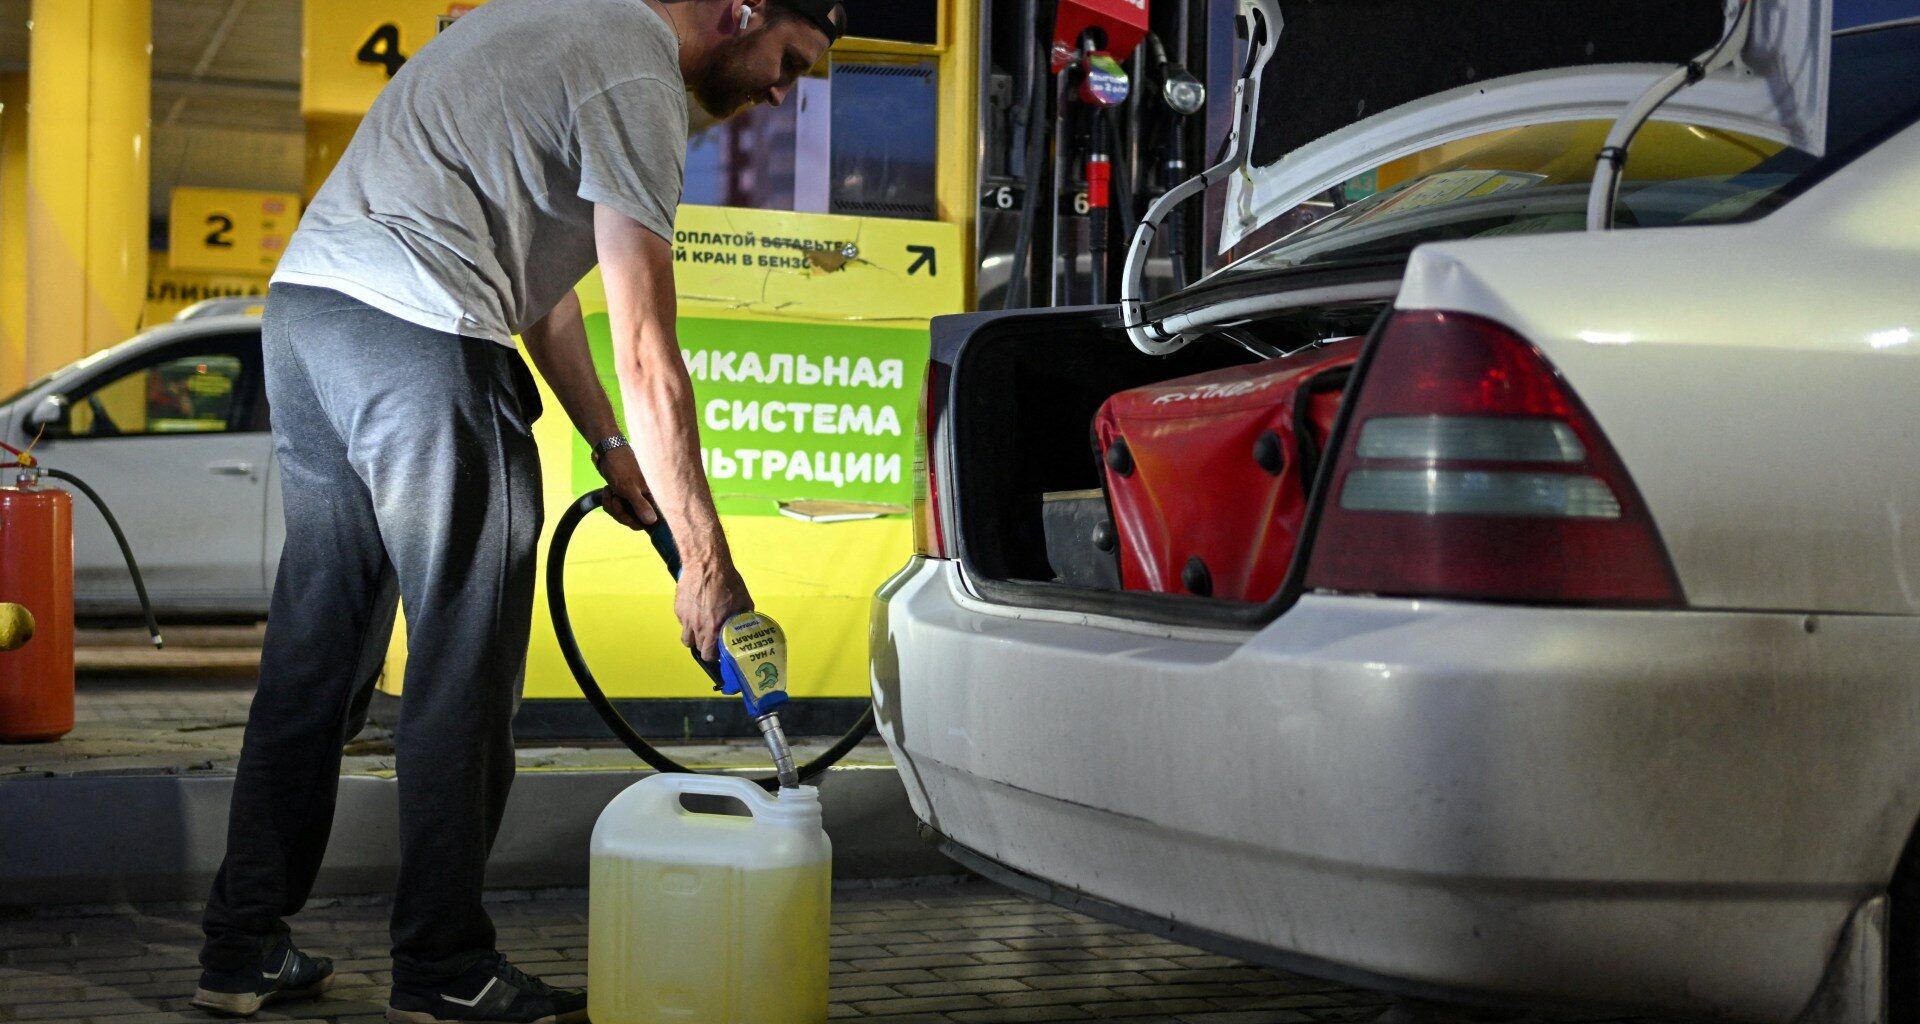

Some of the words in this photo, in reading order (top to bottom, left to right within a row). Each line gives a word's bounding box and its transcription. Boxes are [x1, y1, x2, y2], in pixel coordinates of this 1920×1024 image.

[357, 23, 408, 77] 4
[996, 186, 1013, 208] 6
[1074, 193, 1089, 214] 6
[205, 215, 233, 247] 2
[675, 230, 755, 247] ОПЛАТОЙ
[692, 251, 737, 265] КРАН
[742, 254, 753, 266] В
[704, 398, 901, 437] СИСТЕМА
[731, 626, 776, 646] ЗАПРАВЯТ
[739, 637, 775, 652] ВСЕГДА
[749, 650, 768, 662] НАС
[769, 647, 776, 656] У
